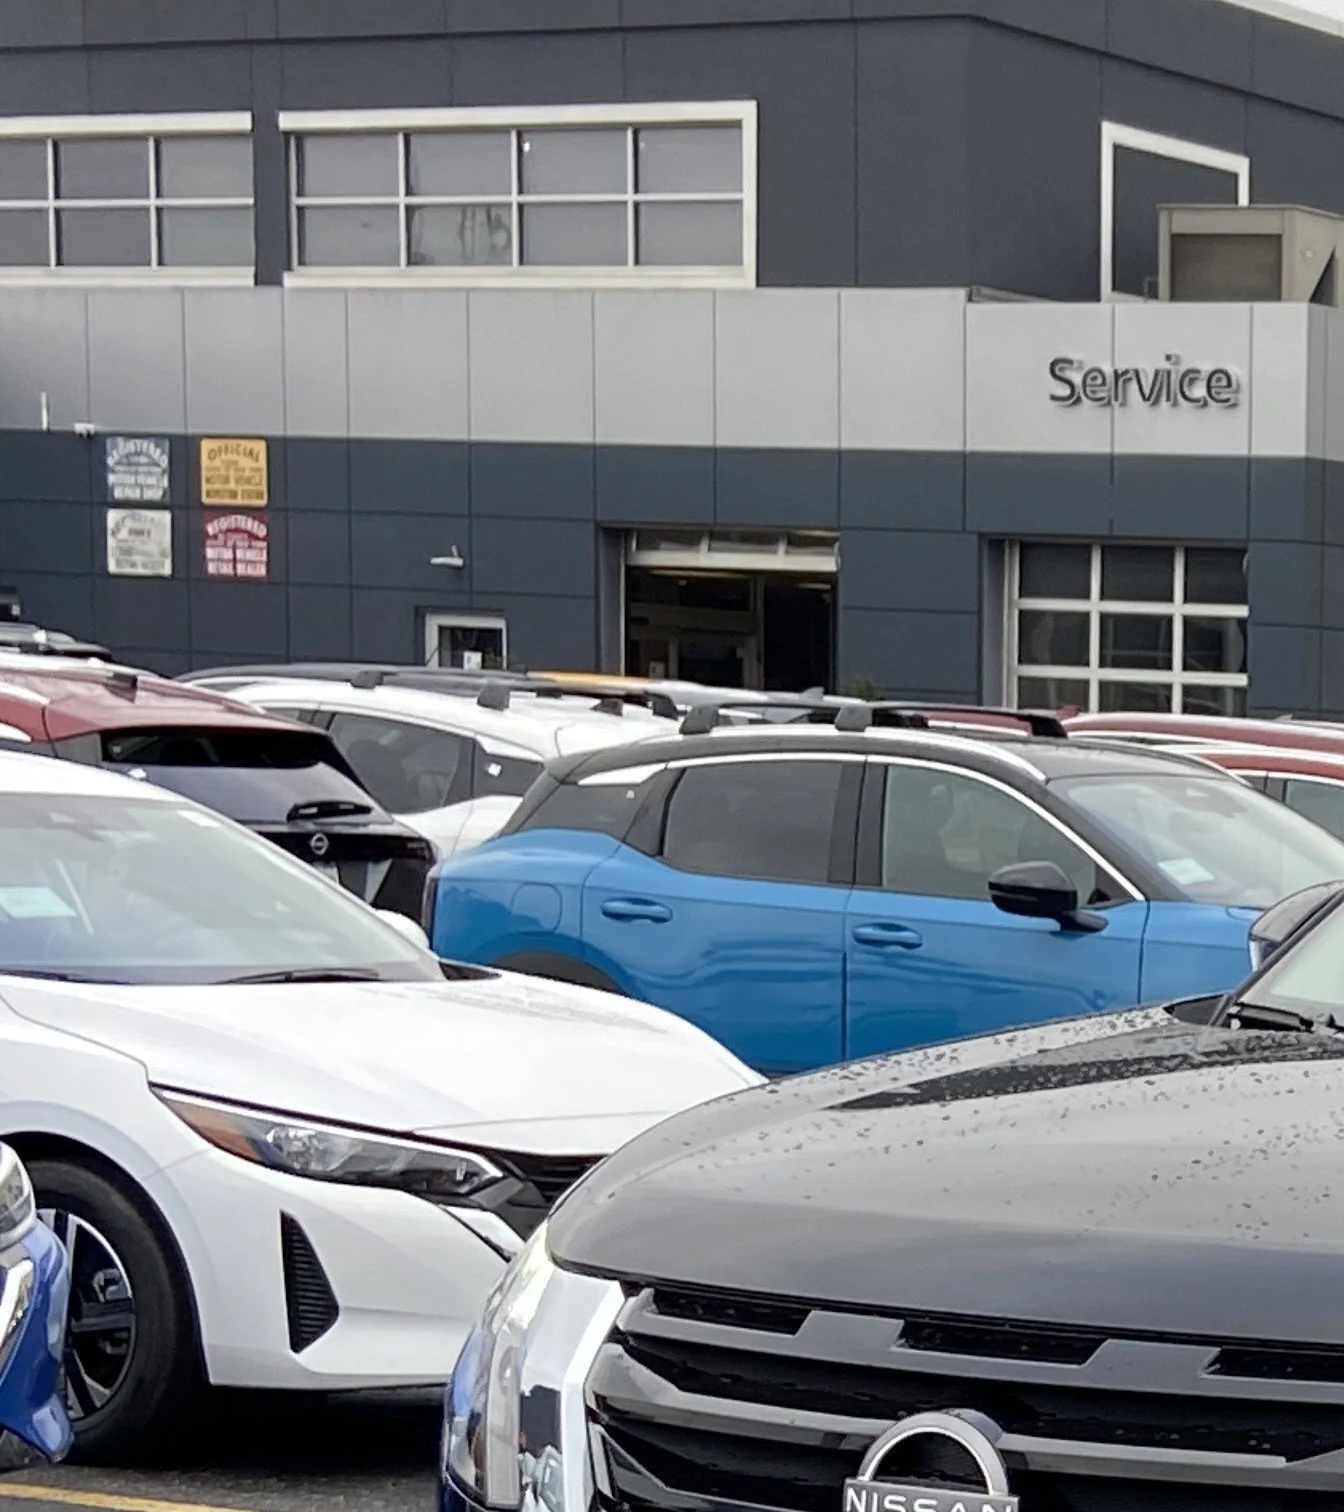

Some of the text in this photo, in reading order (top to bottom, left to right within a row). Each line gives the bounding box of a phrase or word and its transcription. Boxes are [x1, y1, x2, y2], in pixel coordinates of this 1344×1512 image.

[1048, 352, 1240, 408] Service
[206, 443, 260, 464] OFFICIAL
[206, 514, 268, 538] REGISTERED
